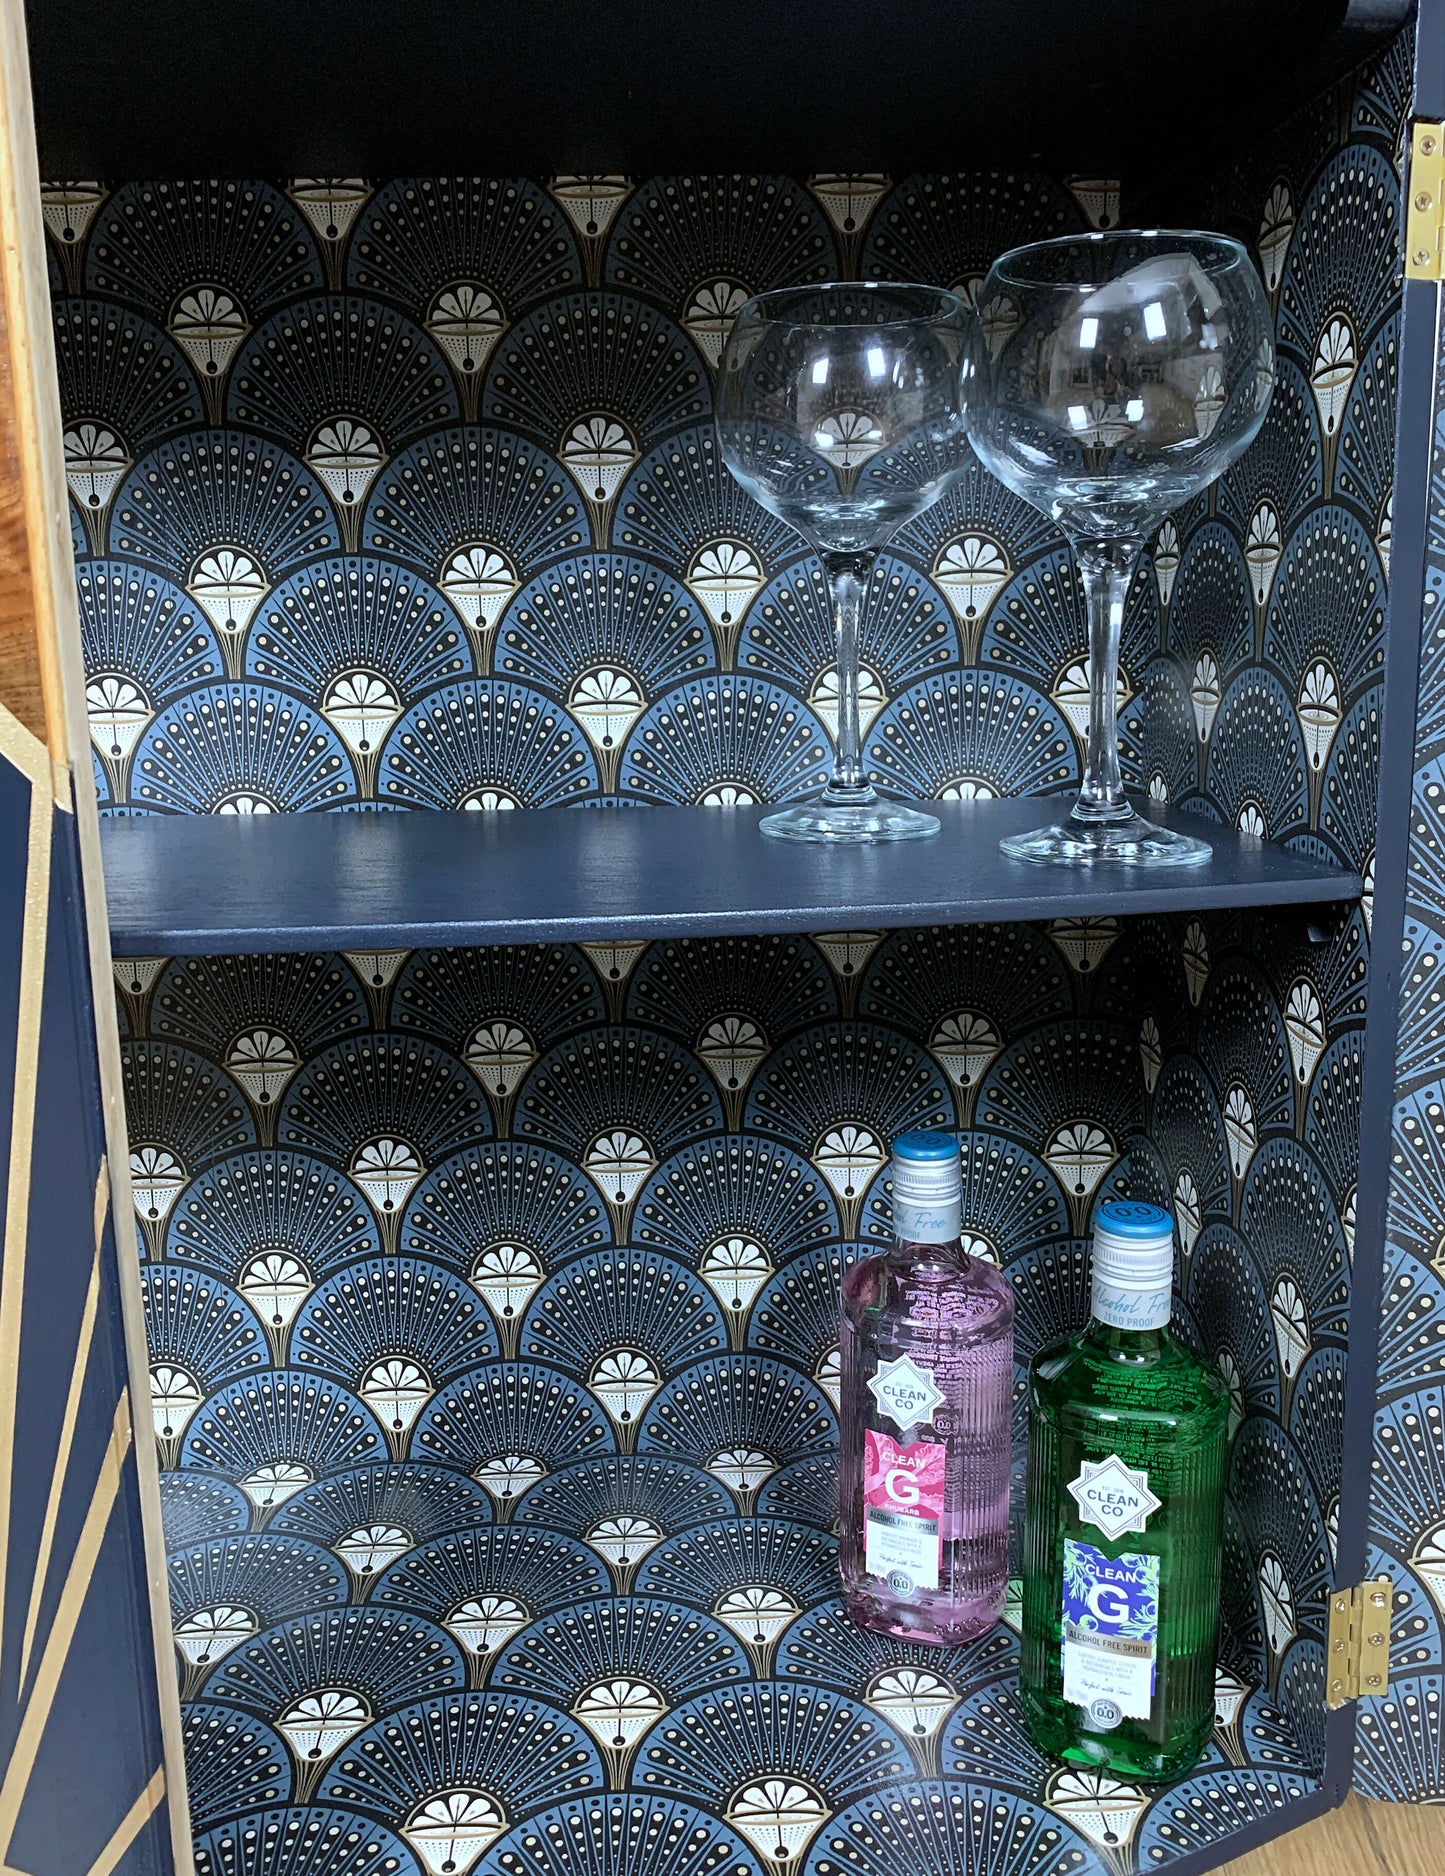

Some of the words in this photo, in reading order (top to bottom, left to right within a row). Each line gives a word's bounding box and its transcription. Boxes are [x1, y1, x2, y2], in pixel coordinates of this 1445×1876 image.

[914, 1211, 945, 1229] Free
[1093, 1286, 1141, 1314] Alcohol
[1103, 1311, 1124, 1325] ZERO
[1126, 1316, 1155, 1328] PROOF
[883, 1385, 927, 1401] CLEAN
[895, 1398, 914, 1410] CO
[882, 1450, 925, 1468] CLEAN
[885, 1468, 920, 1504] G
[1087, 1489, 1139, 1507] CLEAN
[884, 1503, 920, 1516] RHUBARB
[1101, 1504, 1124, 1517] CO
[869, 1510, 896, 1525] ALCOHOL
[897, 1518, 912, 1528] FREE
[915, 1522, 936, 1532] SPIRIT
[1085, 1564, 1136, 1583] CLEAN
[893, 1578, 908, 1590] 0.0
[1088, 1583, 1130, 1623] G
[1069, 1630, 1100, 1646] ALCOHOL
[1102, 1639, 1121, 1650] FREE
[1123, 1643, 1148, 1655] SPIRIT
[1097, 1707, 1115, 1719] 0.0
